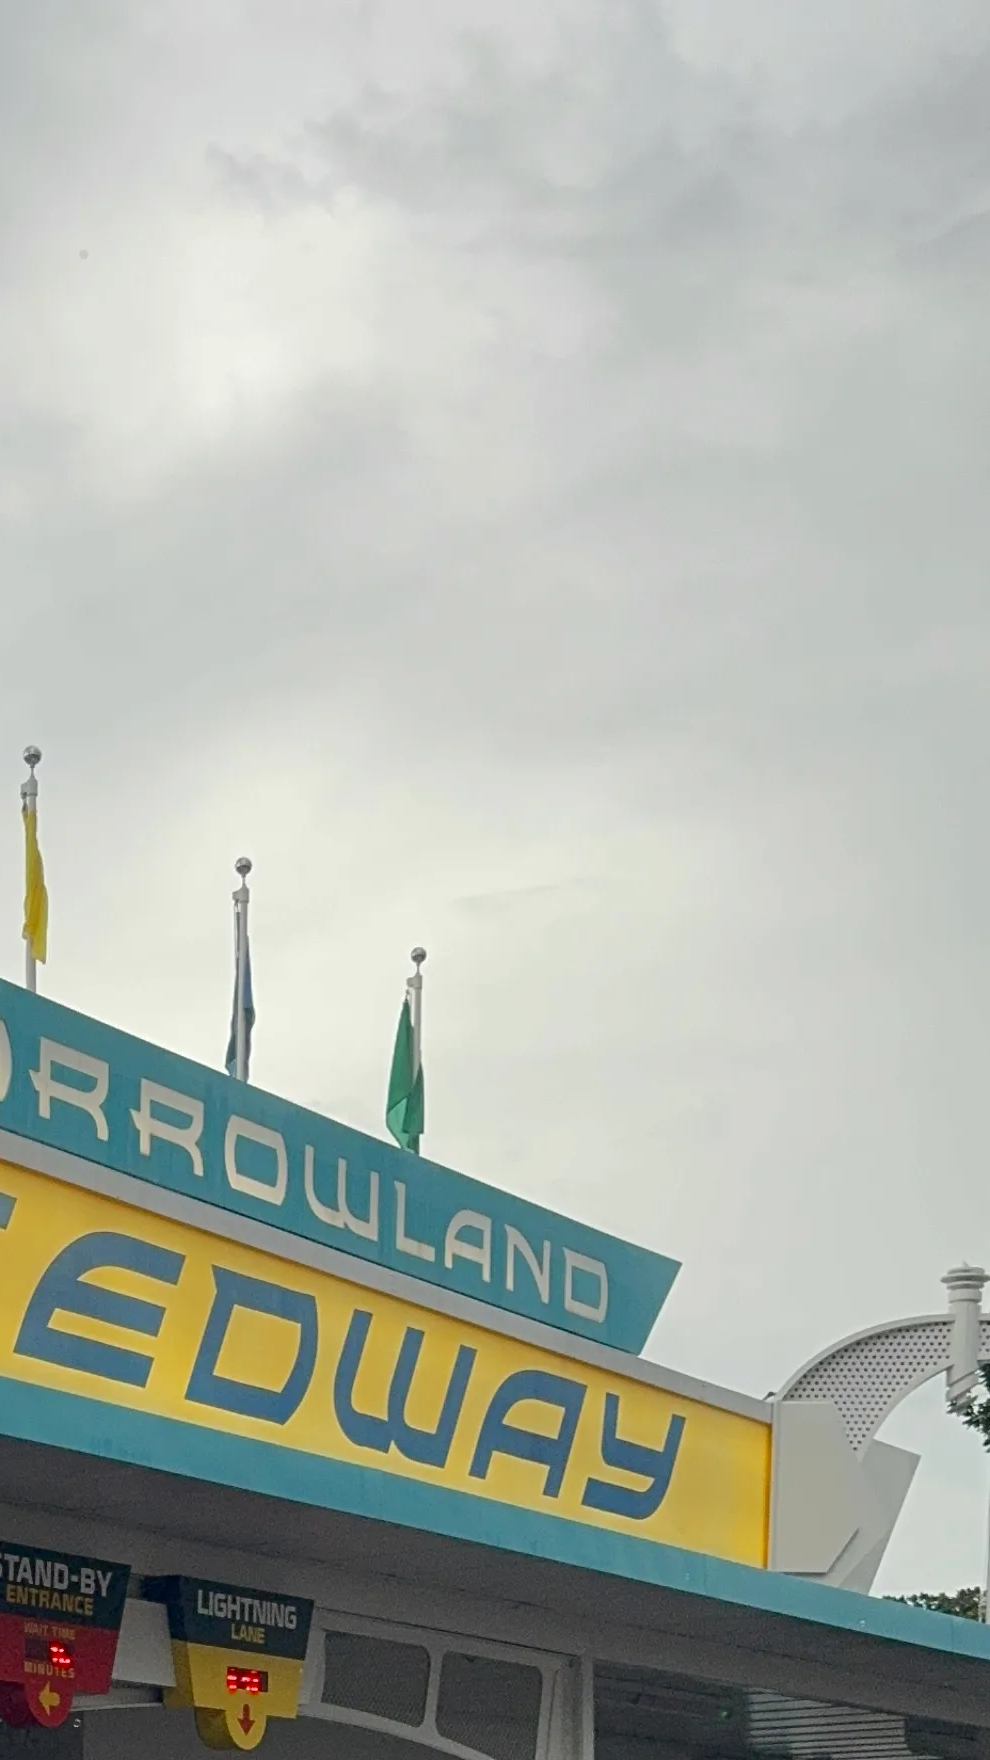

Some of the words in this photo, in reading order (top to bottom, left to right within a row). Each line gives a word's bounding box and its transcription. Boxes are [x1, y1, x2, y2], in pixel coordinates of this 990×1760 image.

[6, 1584, 95, 1617] ENTRANCE
[197, 1589, 298, 1630] LIGHTNING
[23, 1621, 49, 1637] WAIT
[52, 1626, 77, 1641] TIME
[231, 1623, 266, 1645] LANE
[23, 1661, 76, 1679] MINUTES
